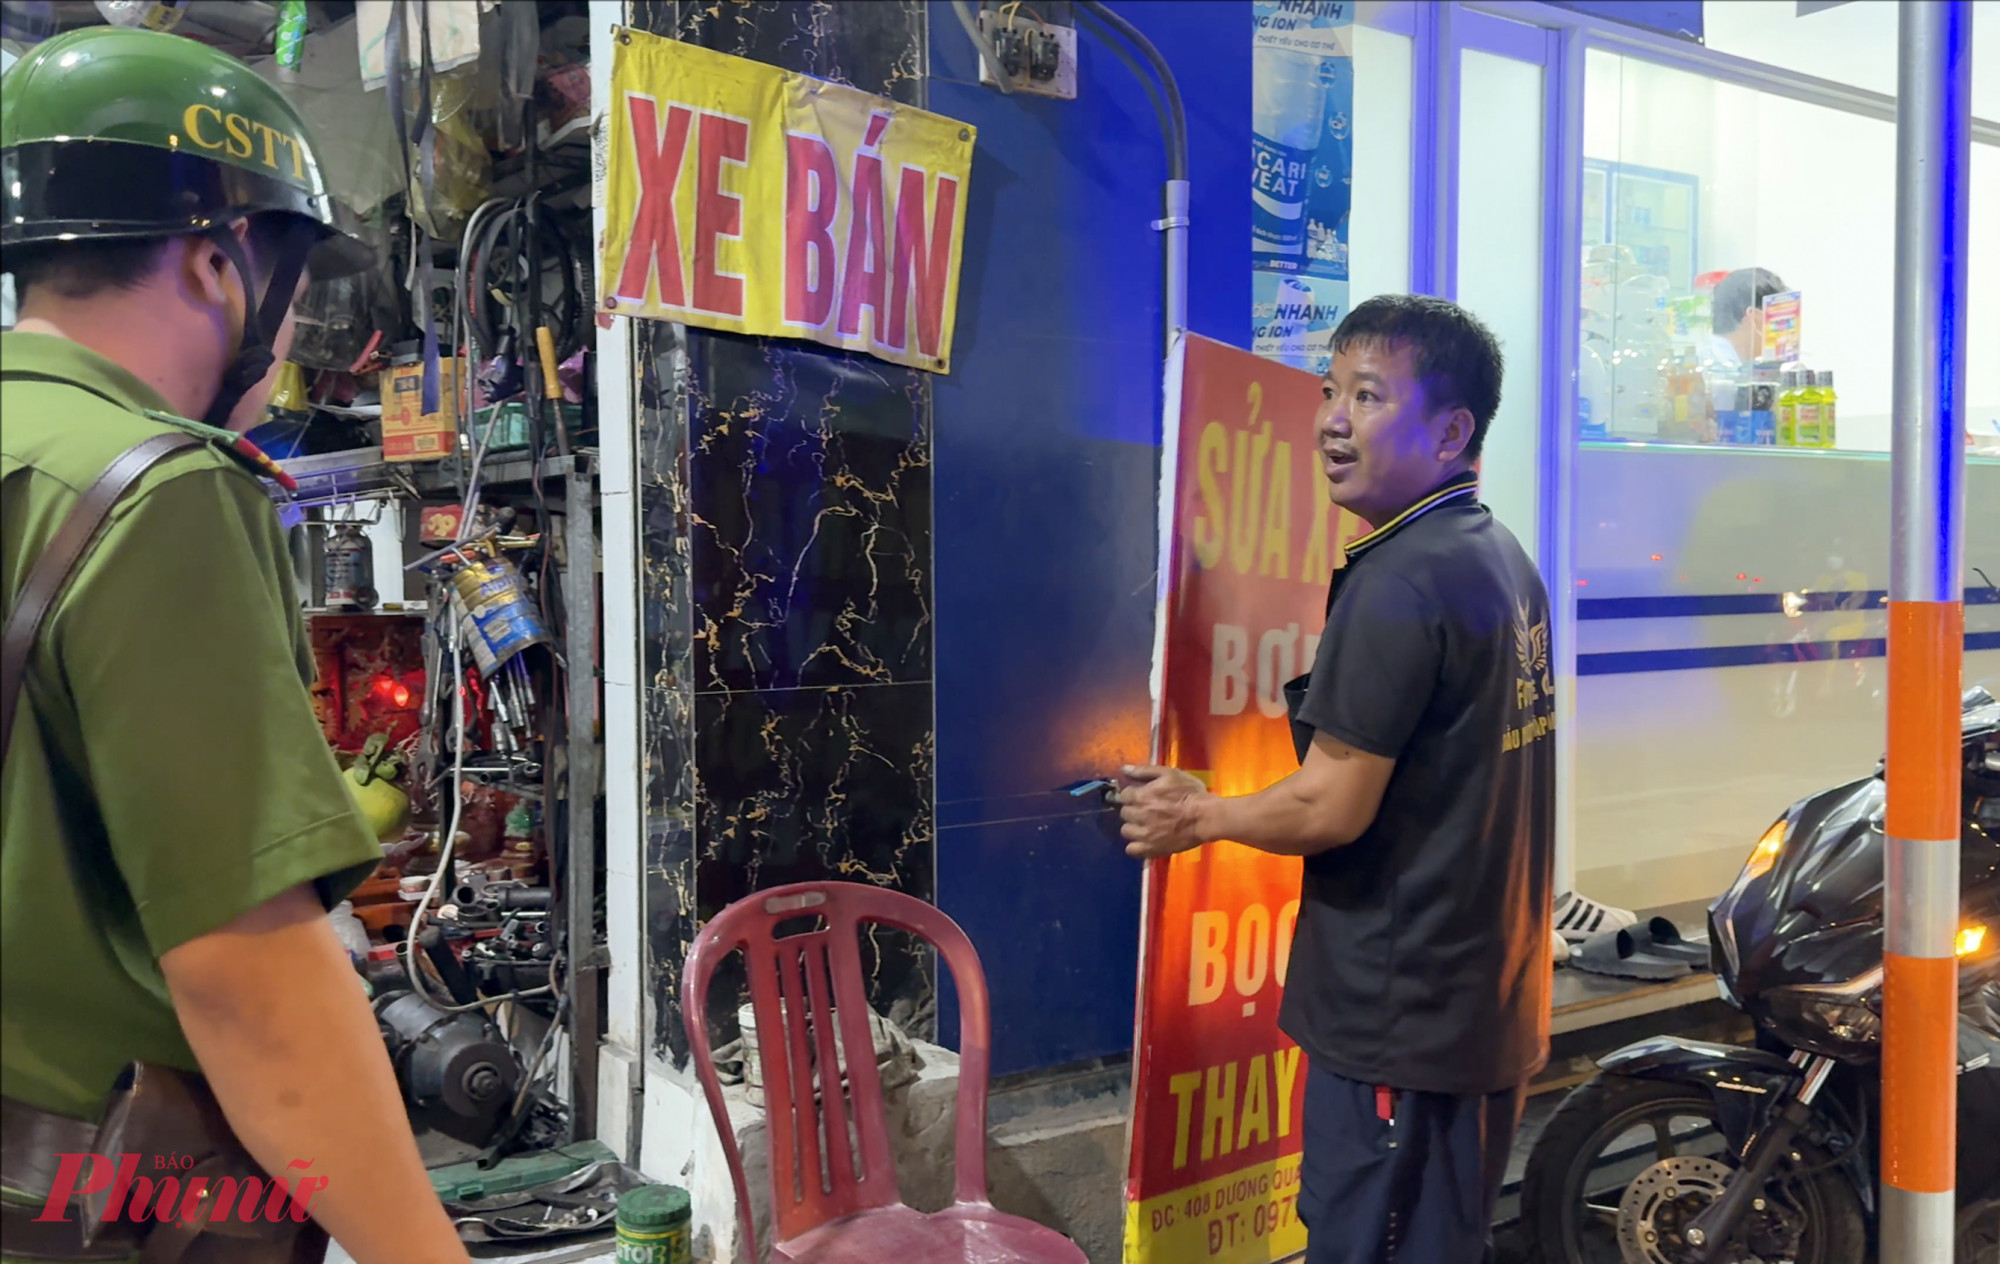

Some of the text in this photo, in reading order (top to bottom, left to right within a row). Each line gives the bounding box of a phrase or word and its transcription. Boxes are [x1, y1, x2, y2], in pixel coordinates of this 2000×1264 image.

[1271, 17, 1298, 31] ION
[183, 104, 306, 181] CSTT
[1252, 147, 1306, 180] CARI
[617, 92, 959, 357] XE BÁN
[1268, 325, 1294, 338] ION
[1275, 303, 1338, 320] NHANH
[1194, 381, 1291, 580] SỬA
[1169, 1046, 1300, 1170] THAY
[1184, 1192, 1210, 1218] 408
[1209, 1195, 1299, 1255] ĐT: 097
